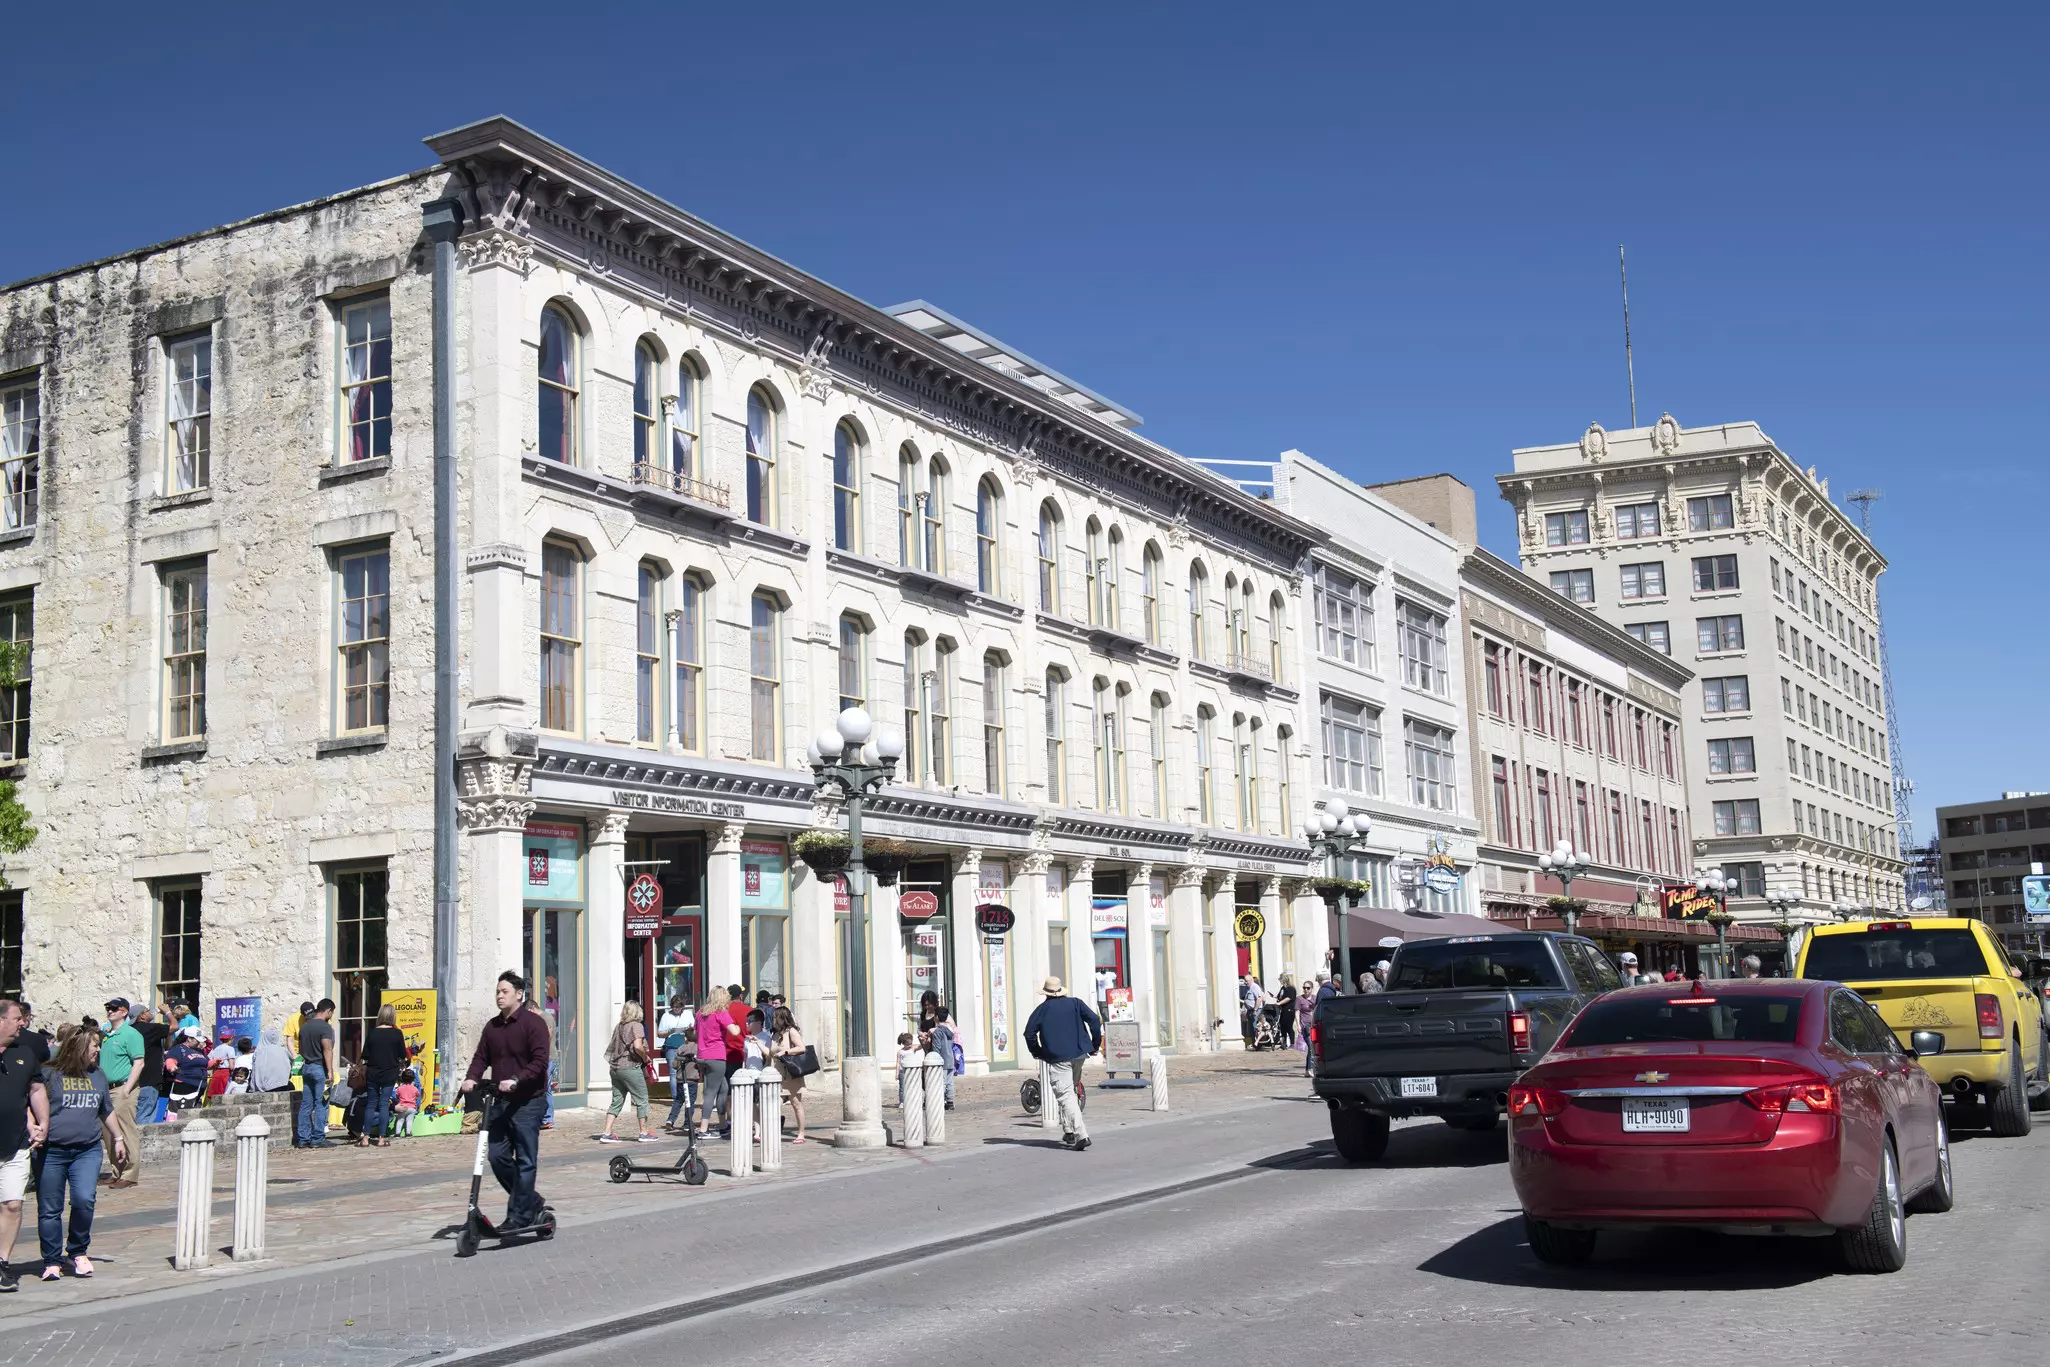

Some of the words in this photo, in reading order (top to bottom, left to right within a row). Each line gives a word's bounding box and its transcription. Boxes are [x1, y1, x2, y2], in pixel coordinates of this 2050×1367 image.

[613, 791, 648, 807] VISITOR
[652, 796, 708, 813] INFORMATION
[711, 802, 745, 817] CENTER
[1110, 847, 1119, 856] DEL
[1121, 848, 1131, 857] SOL
[979, 881, 1002, 899] LOR
[911, 901, 933, 909] ALAMO
[982, 910, 1009, 923] 1718
[915, 936, 937, 945] FRE
[221, 1005, 237, 1019] SEA
[1329, 1018, 1502, 1038] FORD
